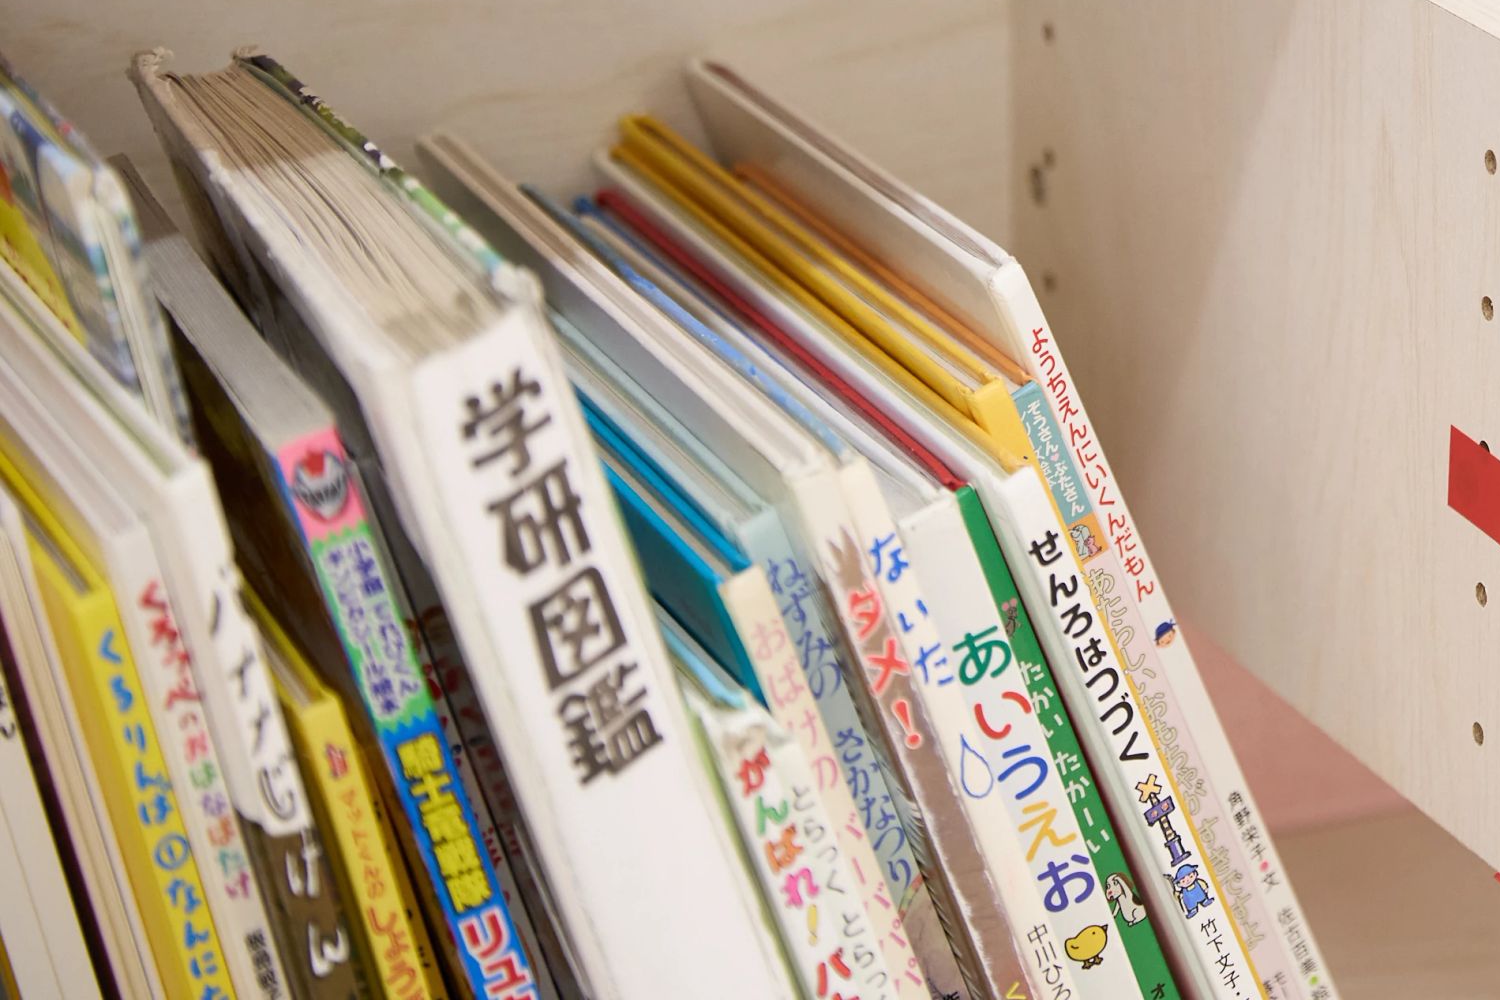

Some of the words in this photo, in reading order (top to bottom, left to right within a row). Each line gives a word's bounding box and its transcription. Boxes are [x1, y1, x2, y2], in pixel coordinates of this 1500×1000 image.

[458, 366, 665, 790] 学研図鑑
[868, 532, 954, 687] ないた
[1028, 529, 1150, 764] せんろはつづく
[767, 558, 842, 698] ねずみの
[834, 728, 912, 890] さかなつり
[950, 624, 1096, 915] あいうえお
[1018, 660, 1064, 740] たかい
[1052, 749, 1111, 855] たかーい
[840, 909, 889, 1000] とらっ
